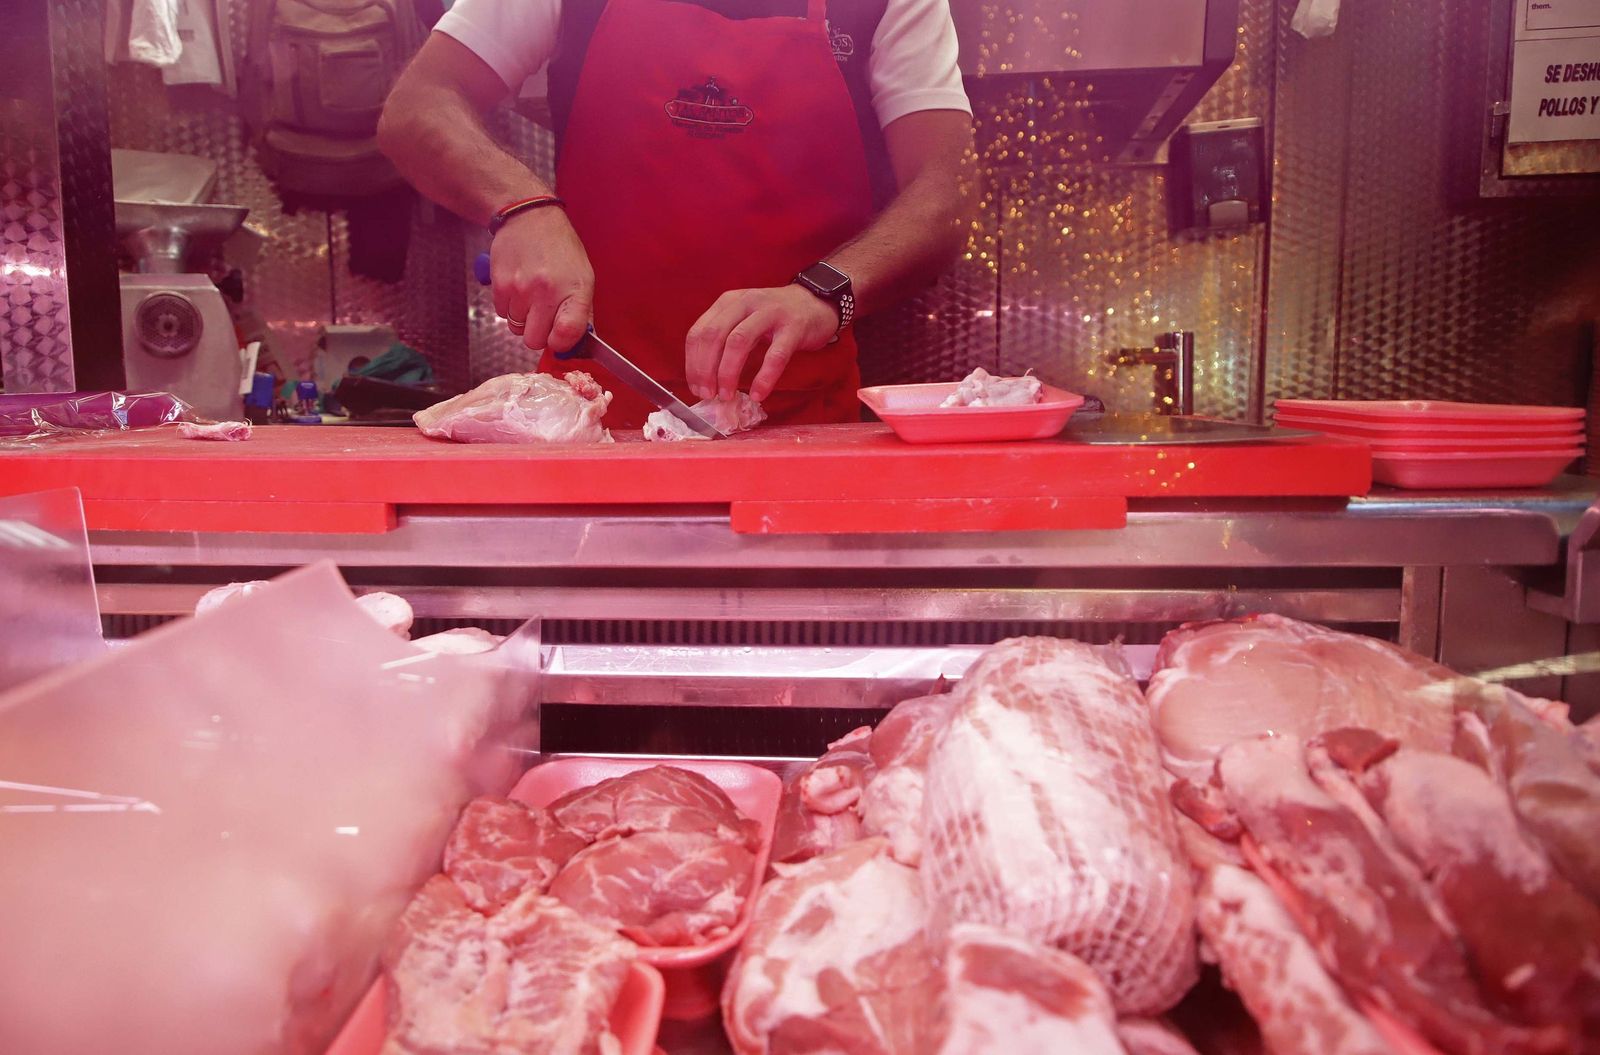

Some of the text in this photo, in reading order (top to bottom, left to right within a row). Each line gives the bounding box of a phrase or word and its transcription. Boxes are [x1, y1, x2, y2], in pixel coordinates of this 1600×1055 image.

[1544, 64, 1562, 84] SE
[1538, 95, 1600, 117] POLLOS Y
